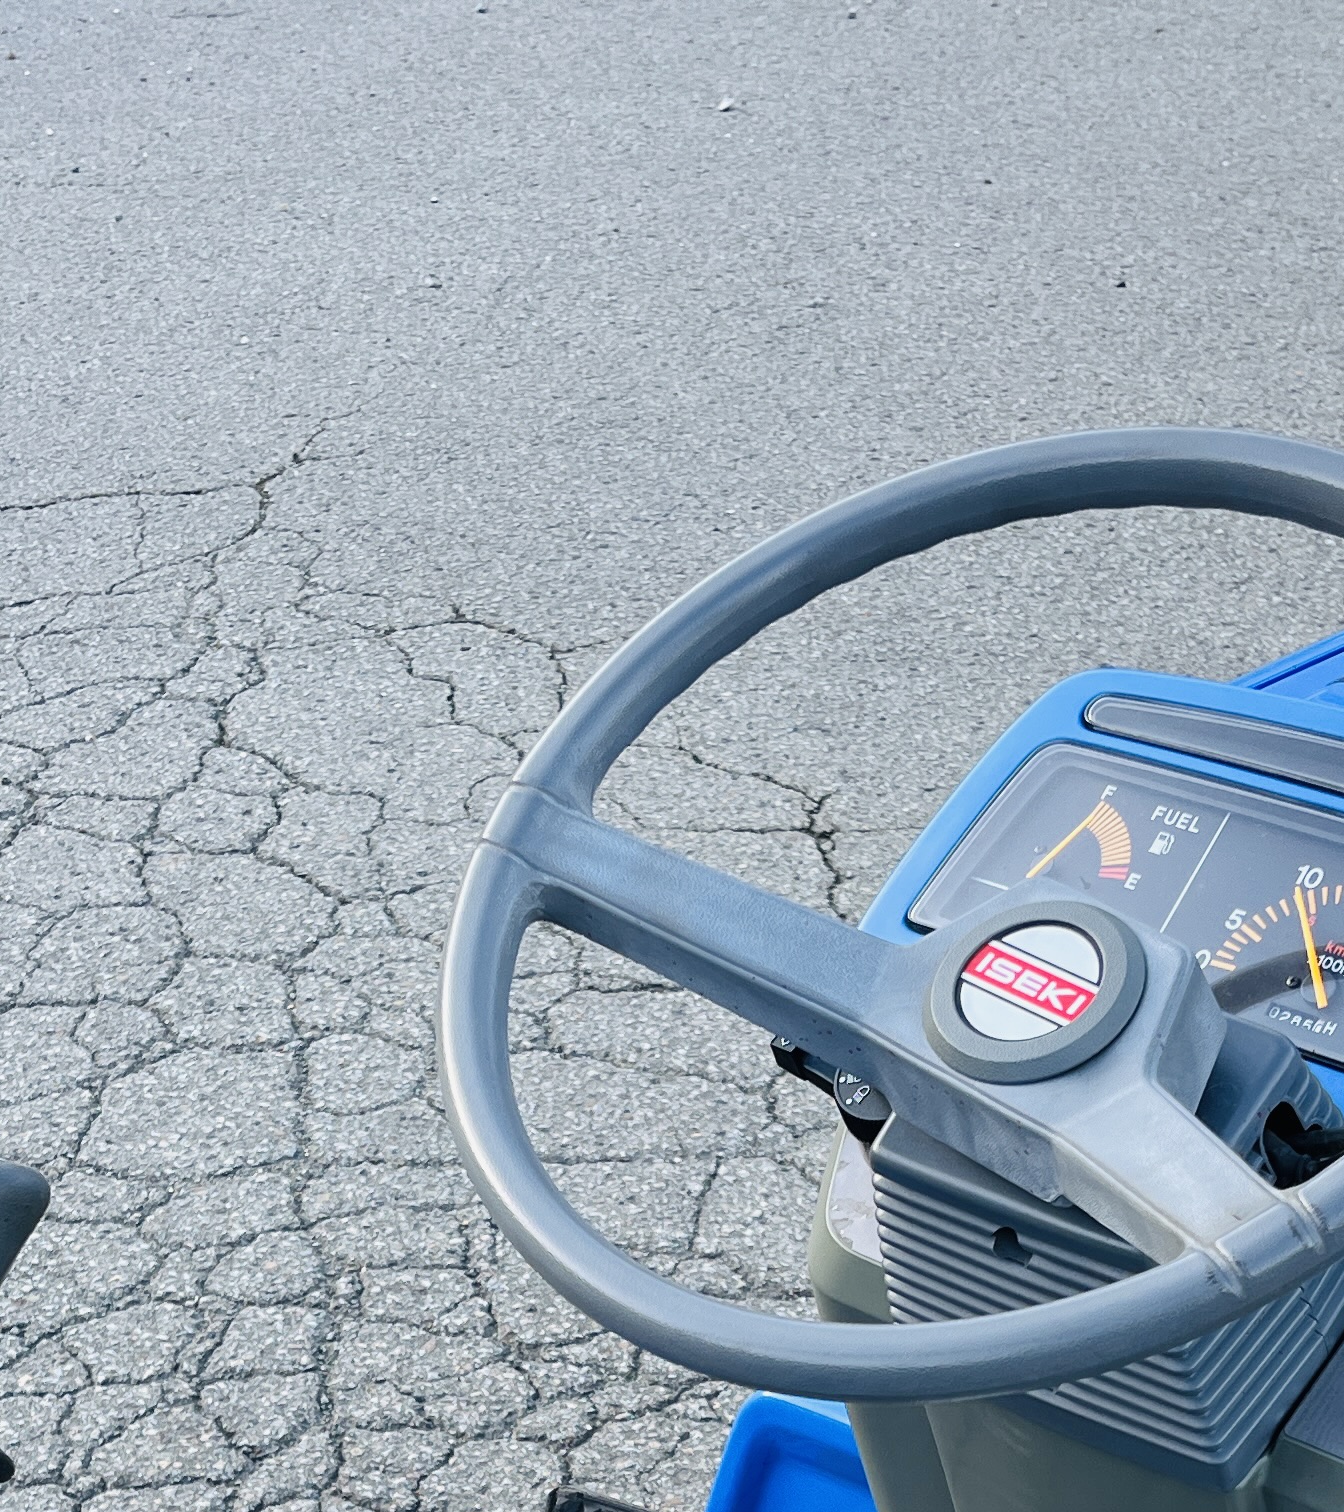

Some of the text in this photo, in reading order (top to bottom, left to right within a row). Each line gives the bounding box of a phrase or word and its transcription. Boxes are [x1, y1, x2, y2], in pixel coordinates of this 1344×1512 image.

[1100, 785, 1117, 800] F
[1150, 805, 1200, 833] FUEL
[1123, 872, 1142, 891] E
[1295, 865, 1324, 889] 10
[1224, 908, 1247, 931] 5
[974, 952, 1087, 1016] ISEKI
